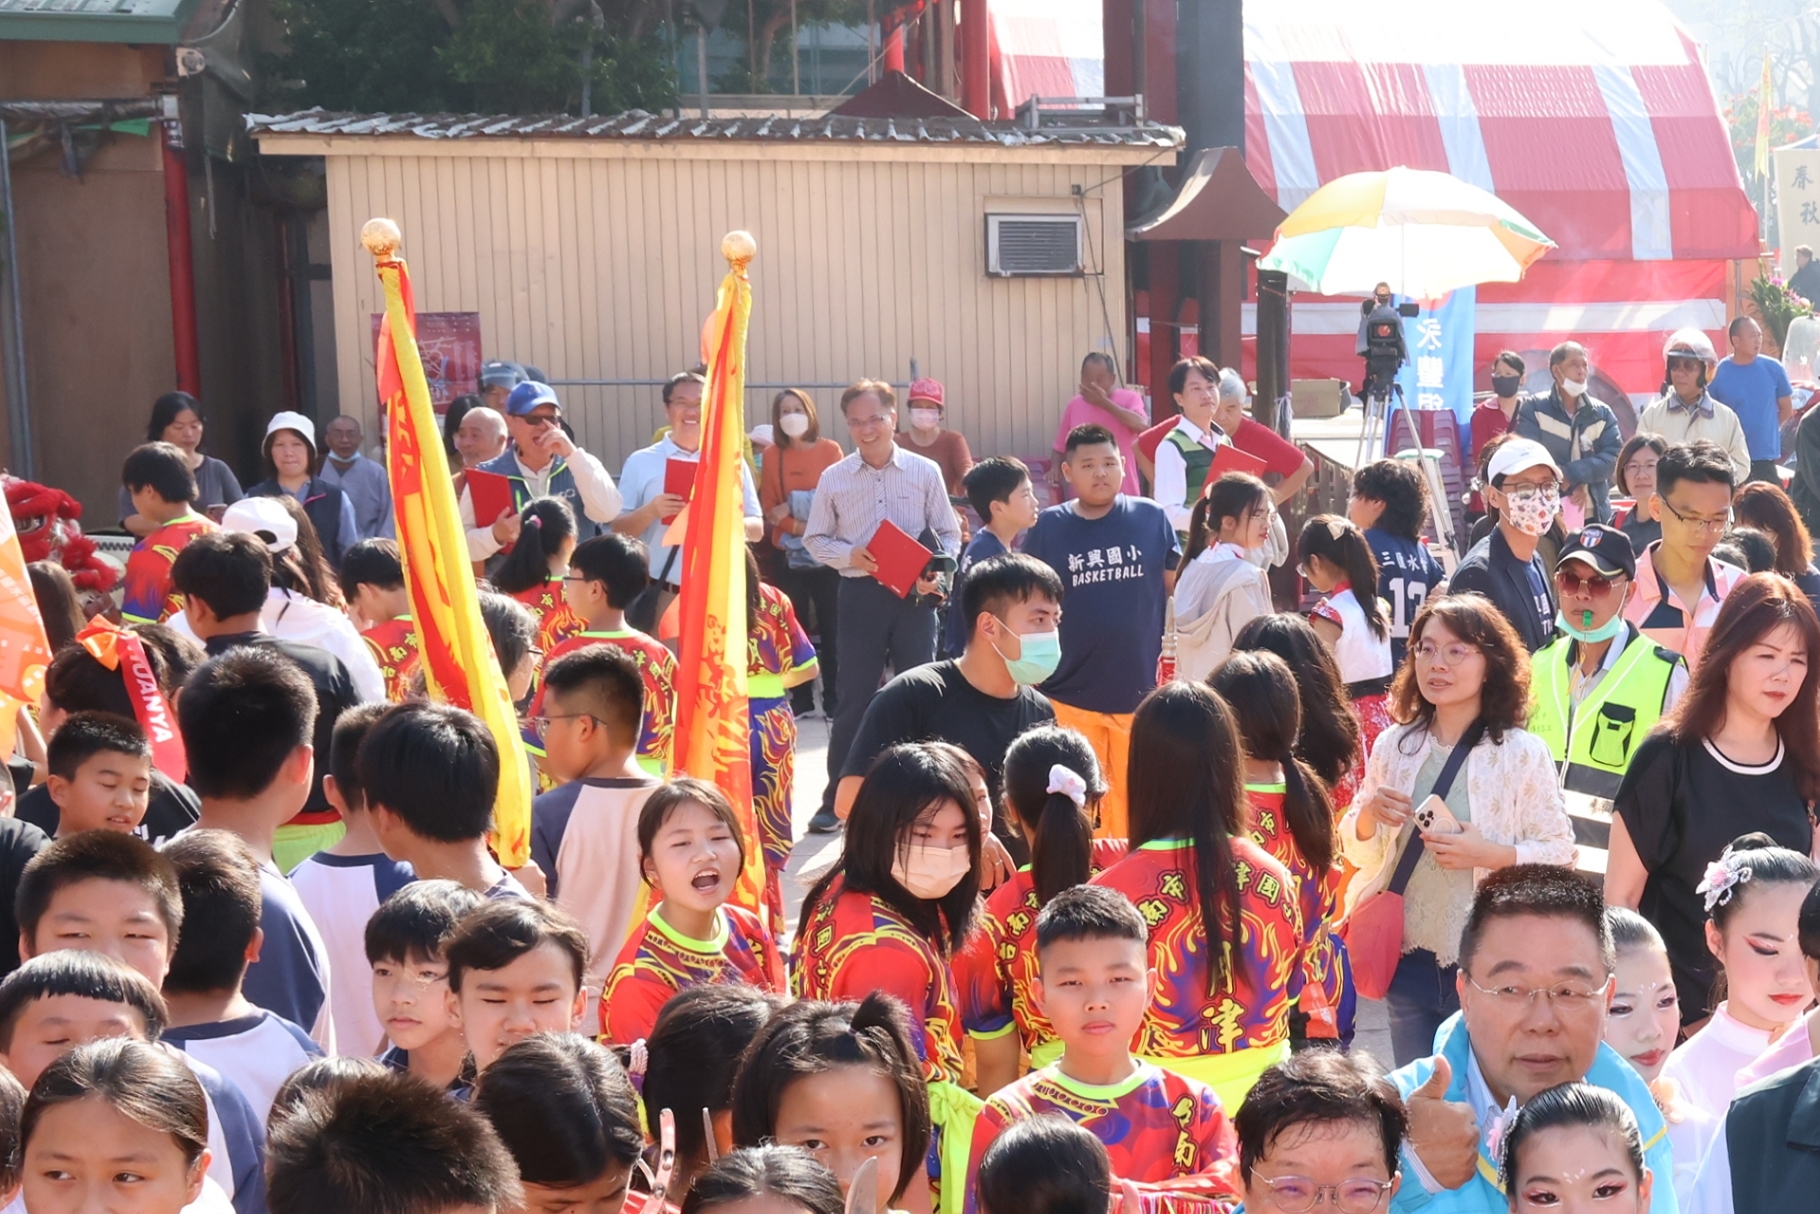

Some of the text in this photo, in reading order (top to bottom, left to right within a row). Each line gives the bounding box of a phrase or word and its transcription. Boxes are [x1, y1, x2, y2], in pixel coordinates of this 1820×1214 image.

[1791, 165, 1820, 226] 春秋
[1067, 545, 1142, 573] 新興國小
[1072, 564, 1144, 587] BASKETBALL
